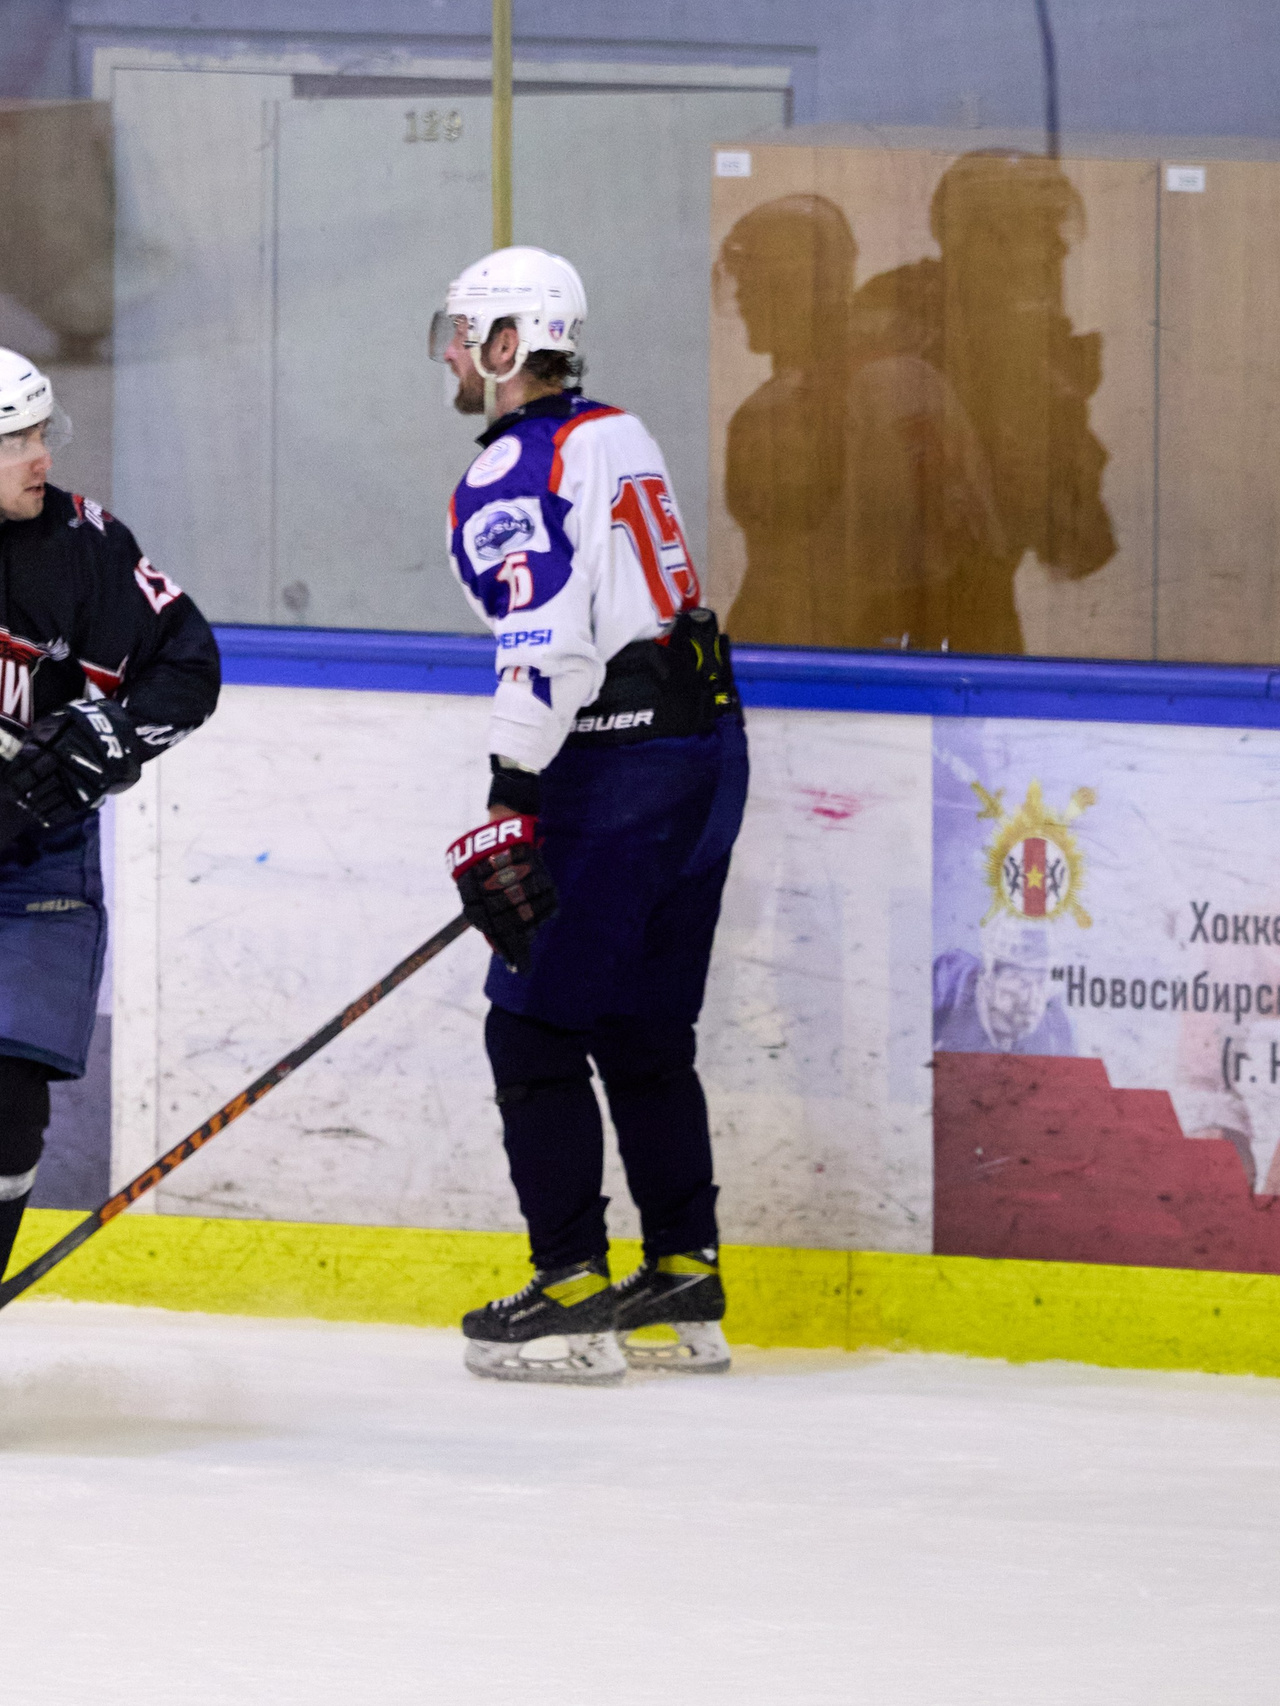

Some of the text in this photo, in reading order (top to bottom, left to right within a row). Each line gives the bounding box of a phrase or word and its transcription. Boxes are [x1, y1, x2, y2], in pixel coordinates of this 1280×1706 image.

[498, 629, 553, 649] EPSI
[68, 699, 124, 759] UER
[570, 708, 654, 733] AUER
[446, 817, 523, 869] UER
[1050, 964, 1280, 1026] “Новосибирс
[1222, 1036, 1257, 1092] (г.
[100, 1091, 254, 1226] SOYUZ
